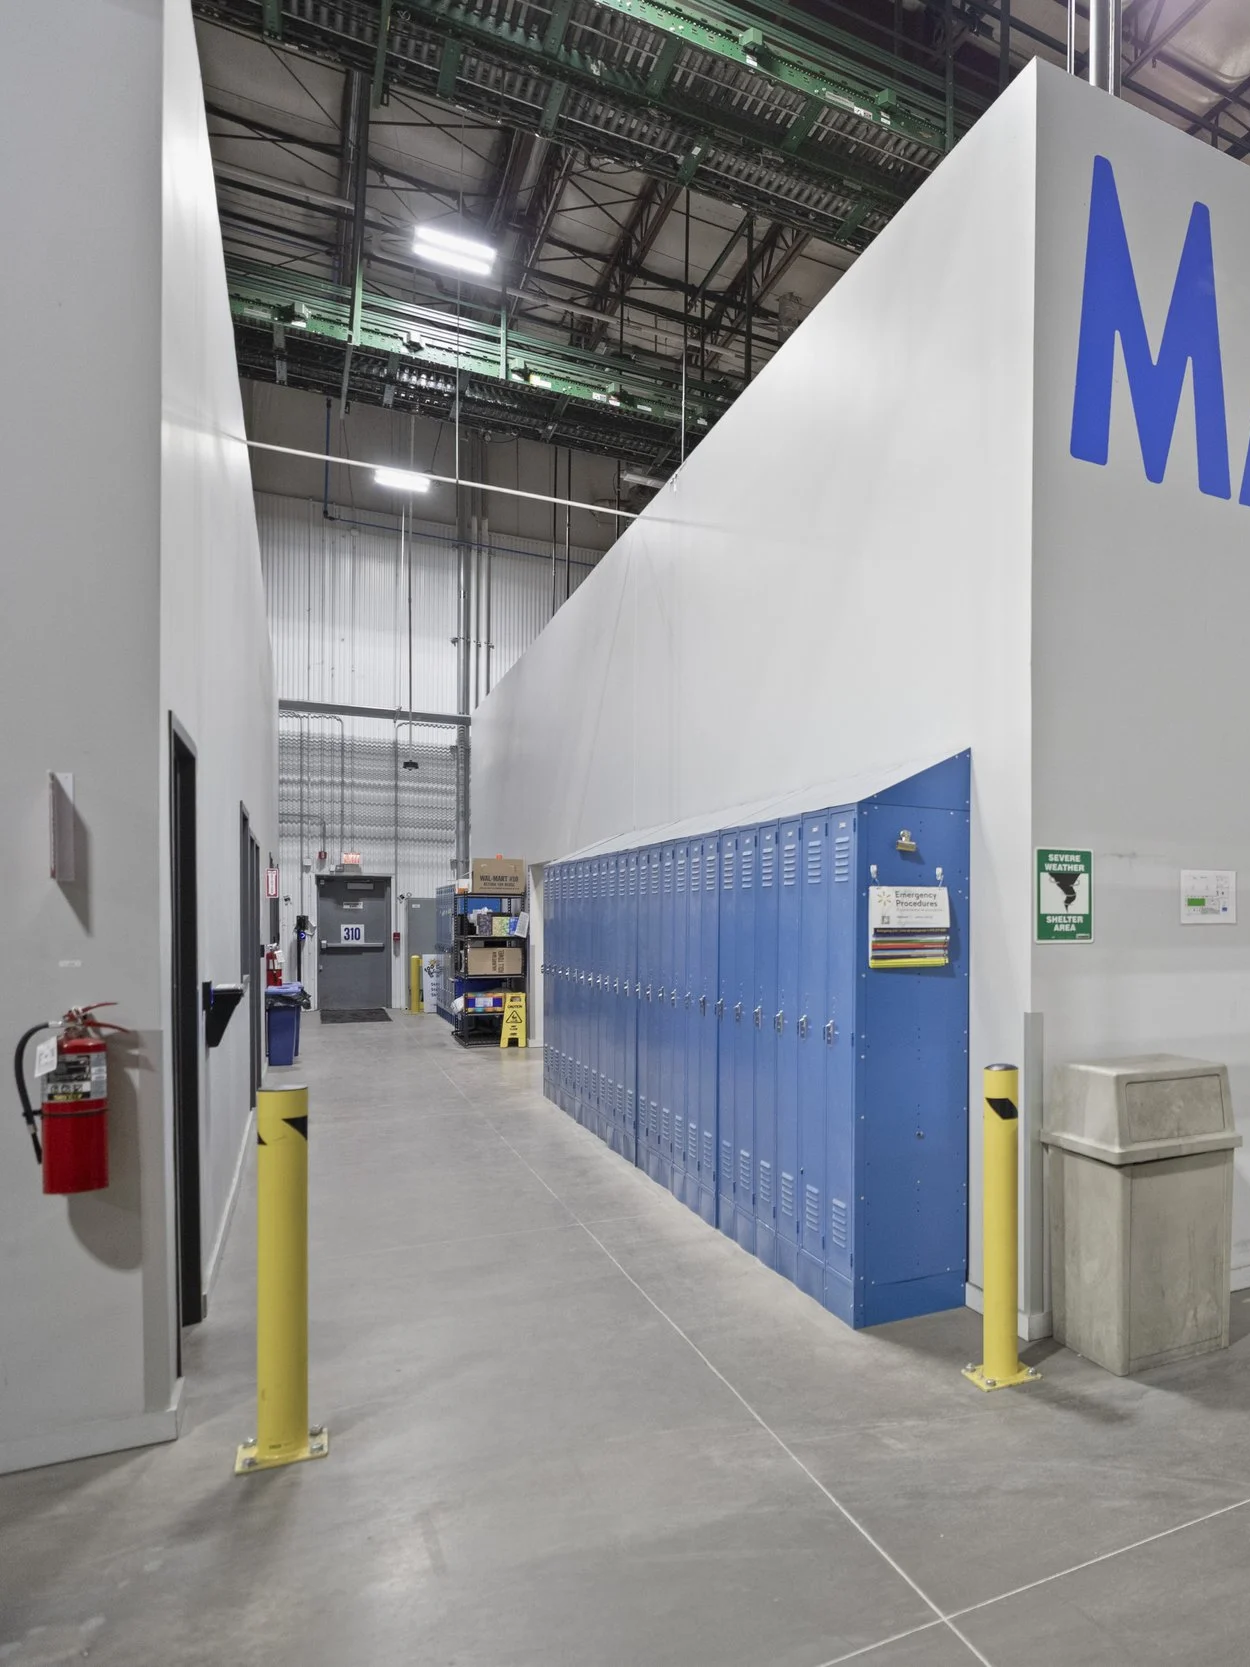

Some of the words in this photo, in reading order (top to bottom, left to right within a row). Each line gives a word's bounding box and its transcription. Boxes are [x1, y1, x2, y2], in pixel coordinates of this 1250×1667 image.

[1048, 853, 1081, 863] SEVERE
[1044, 863, 1085, 872] WEATHER
[895, 891, 937, 900] Emergency
[1046, 915, 1084, 924] SHELTER
[1053, 923, 1077, 932] AREA
[343, 927, 361, 941] 310
